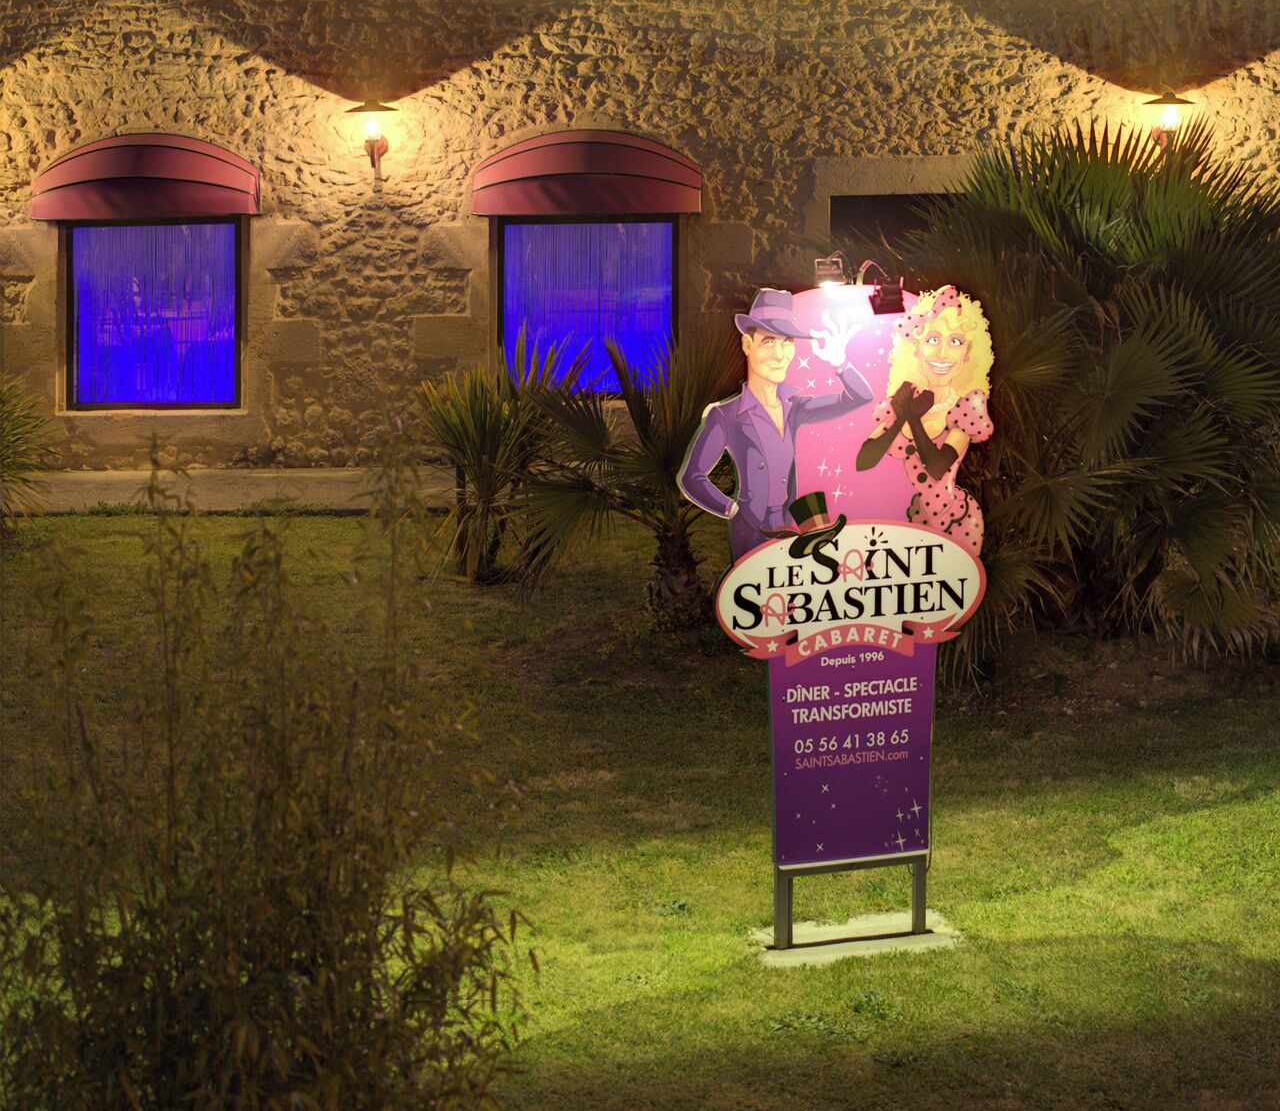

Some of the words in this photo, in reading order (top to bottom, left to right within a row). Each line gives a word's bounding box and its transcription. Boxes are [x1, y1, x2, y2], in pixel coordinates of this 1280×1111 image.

[766, 565, 804, 589] LE
[811, 537, 944, 585] SAINT
[732, 578, 969, 630] SABASTIEN
[798, 627, 903, 657] CABARET
[820, 654, 857, 668] Depuis
[859, 651, 885, 663] 1996
[786, 684, 831, 704] DÎNER
[843, 677, 918, 698] SPECTACLE
[792, 698, 913, 724] TRANSFORMISTE
[794, 739, 814, 754] 05
[818, 736, 838, 752] 56
[842, 734, 861, 749] 41
[866, 732, 886, 747] 38
[890, 729, 909, 745] 65
[795, 750, 909, 770] SAINTSABASTIEN.com
